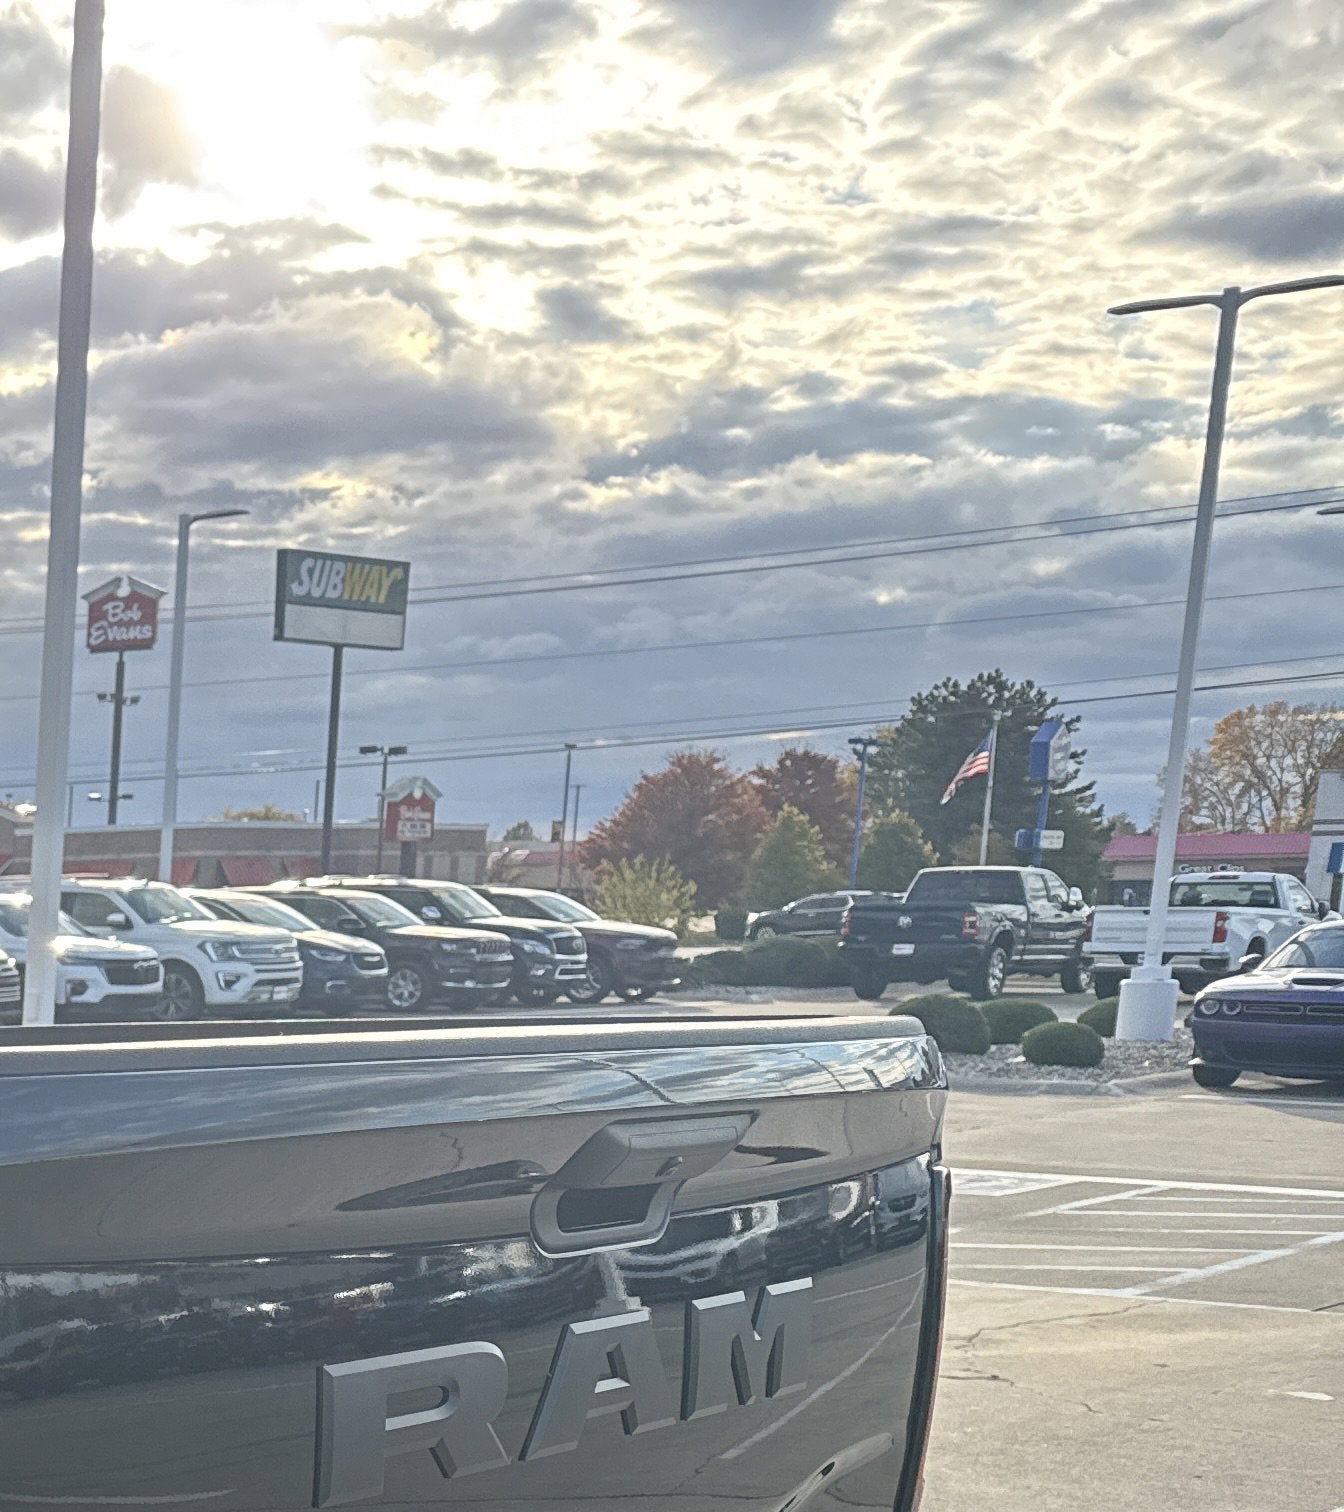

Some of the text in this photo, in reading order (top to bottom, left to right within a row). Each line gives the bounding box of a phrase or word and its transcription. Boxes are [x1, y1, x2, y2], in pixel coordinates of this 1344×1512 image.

[291, 557, 404, 603] SUBWAY
[102, 601, 142, 622] Bob
[89, 621, 153, 646] Evans
[313, 1278, 812, 1508] RAM
